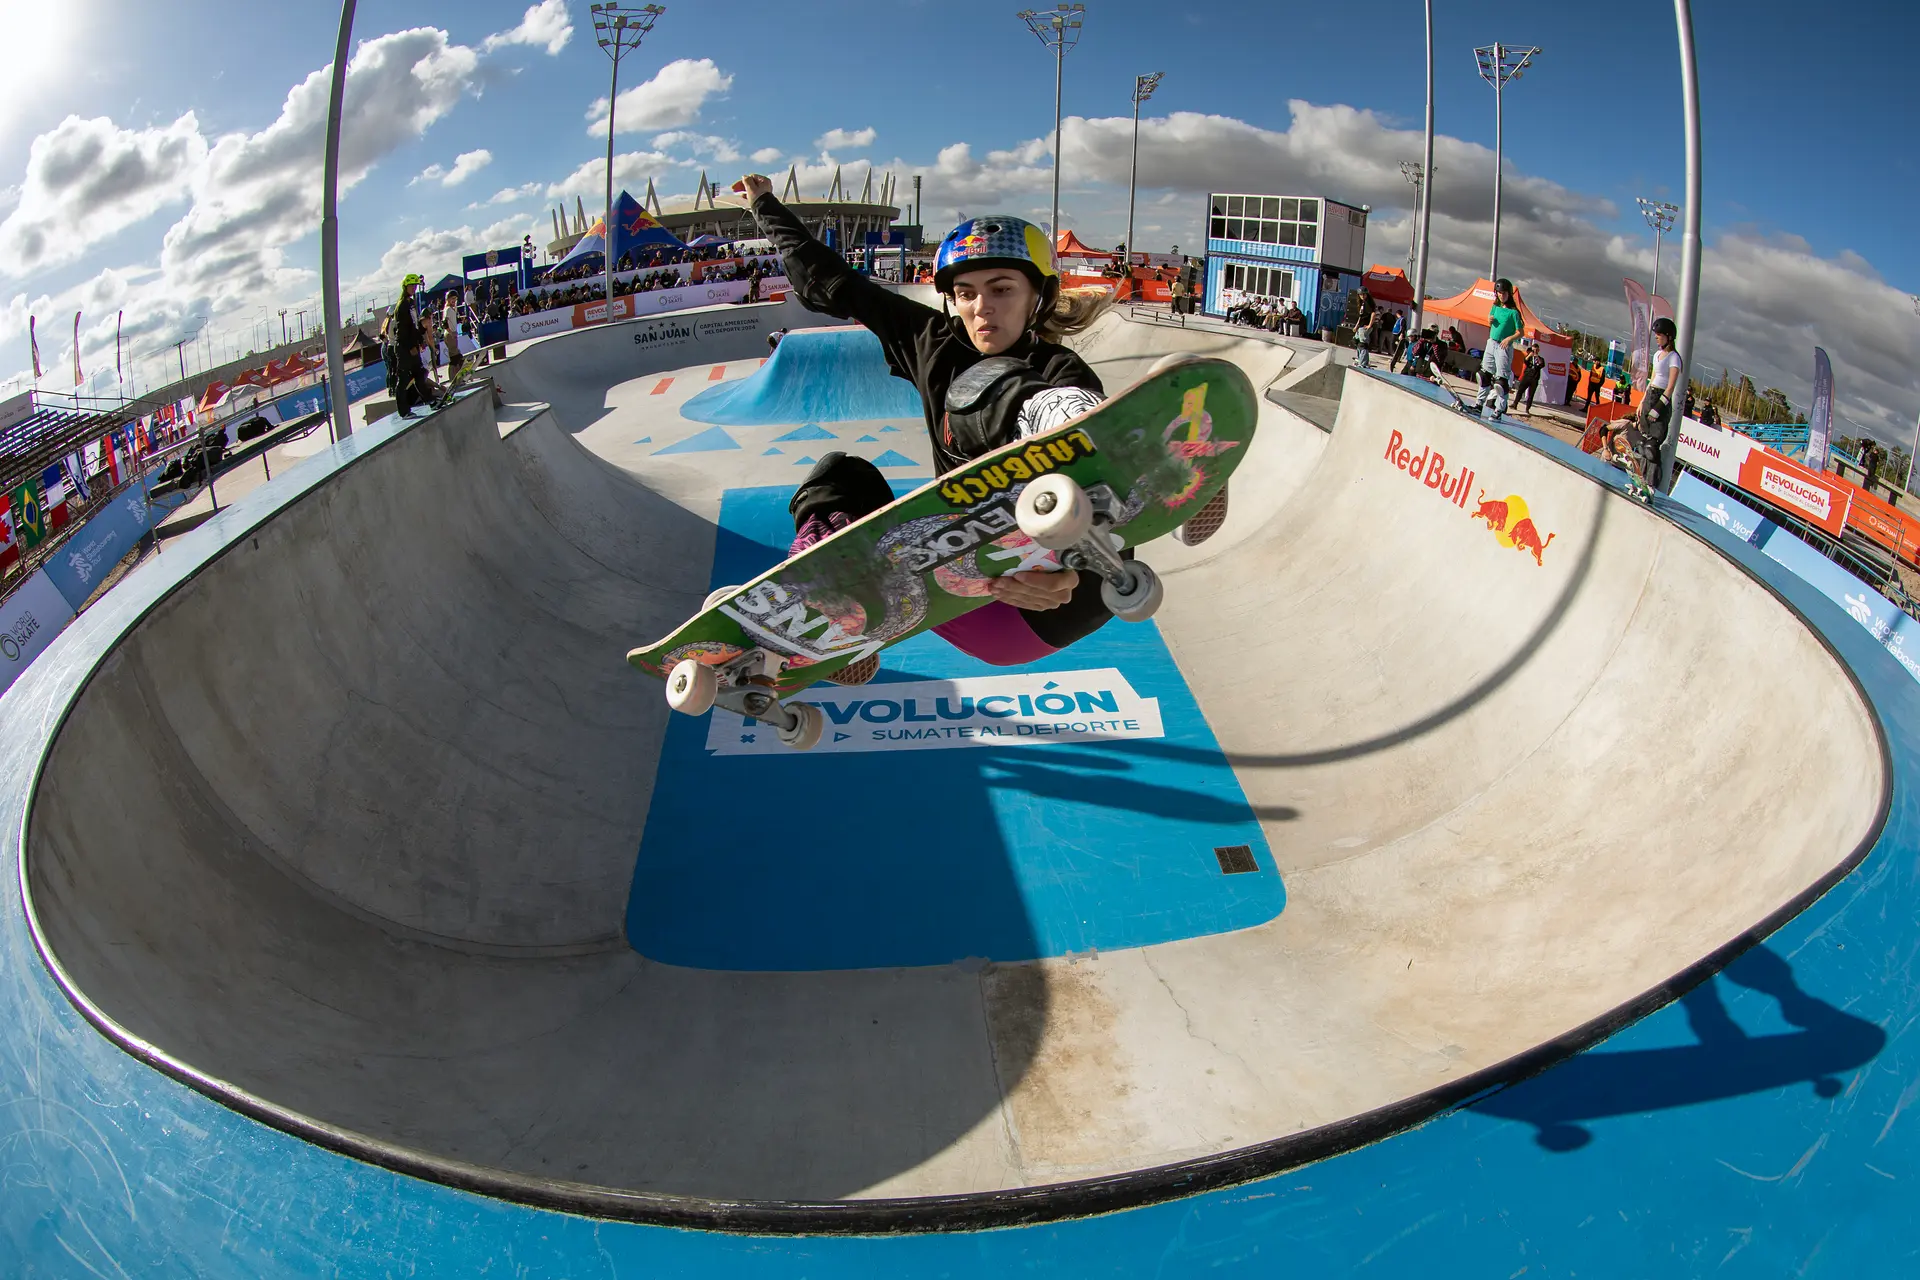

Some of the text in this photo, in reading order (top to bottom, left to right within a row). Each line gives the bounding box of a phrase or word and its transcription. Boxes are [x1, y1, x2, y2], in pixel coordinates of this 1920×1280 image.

[952, 245, 987, 258] Red Bull
[586, 303, 624, 315] REVOLIÓN
[532, 318, 559, 329] SAN JUAN
[699, 318, 759, 330] CAPITAL AMERICANA
[716, 326, 741, 334] DEPORTE
[634, 327, 690, 345] SAN JUAN
[1678, 433, 1721, 459] SAN JUAN
[941, 432, 1094, 504] LAYBACK
[1384, 429, 1475, 509] Red Bull
[1765, 471, 1826, 508] REVOLUCIÓN
[1732, 519, 1760, 541] World
[10, 610, 33, 636] WORLD
[18, 618, 40, 647] SKATE
[1874, 616, 1905, 645] World
[742, 680, 1120, 727] VOLUCIÓN
[872, 719, 1140, 741] SUMATE AL DEPORTE
